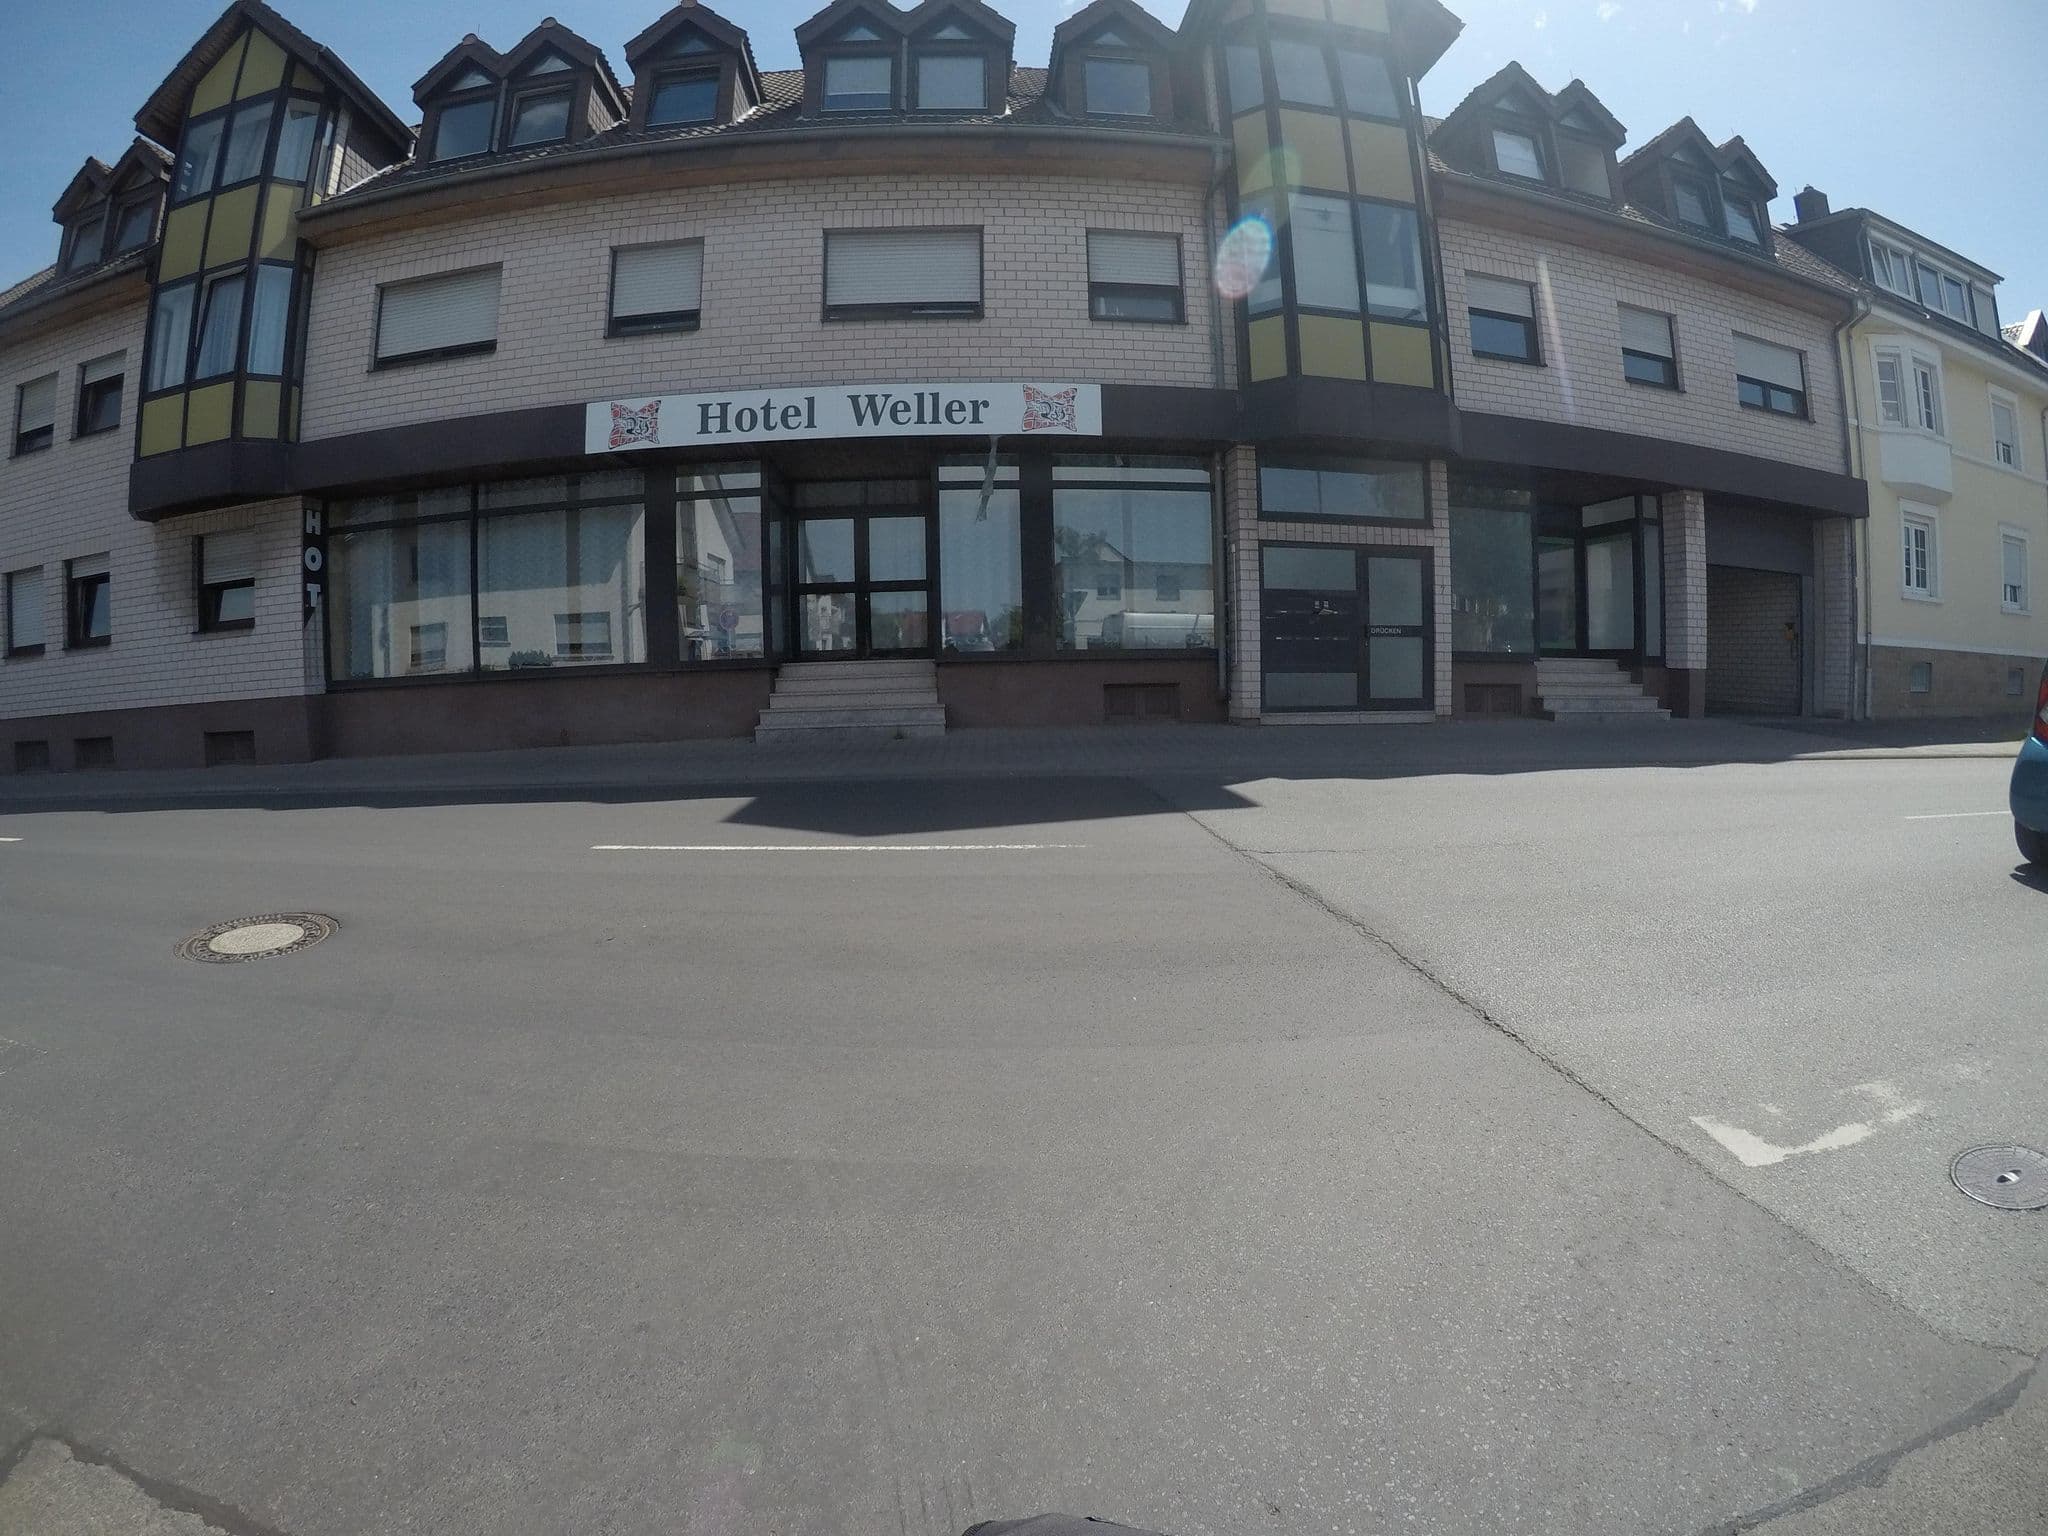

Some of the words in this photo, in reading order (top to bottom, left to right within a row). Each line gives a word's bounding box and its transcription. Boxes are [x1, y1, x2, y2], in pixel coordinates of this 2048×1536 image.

[696, 396, 818, 435] Hotel
[847, 391, 990, 427] Weller
[305, 510, 323, 608] HOT
